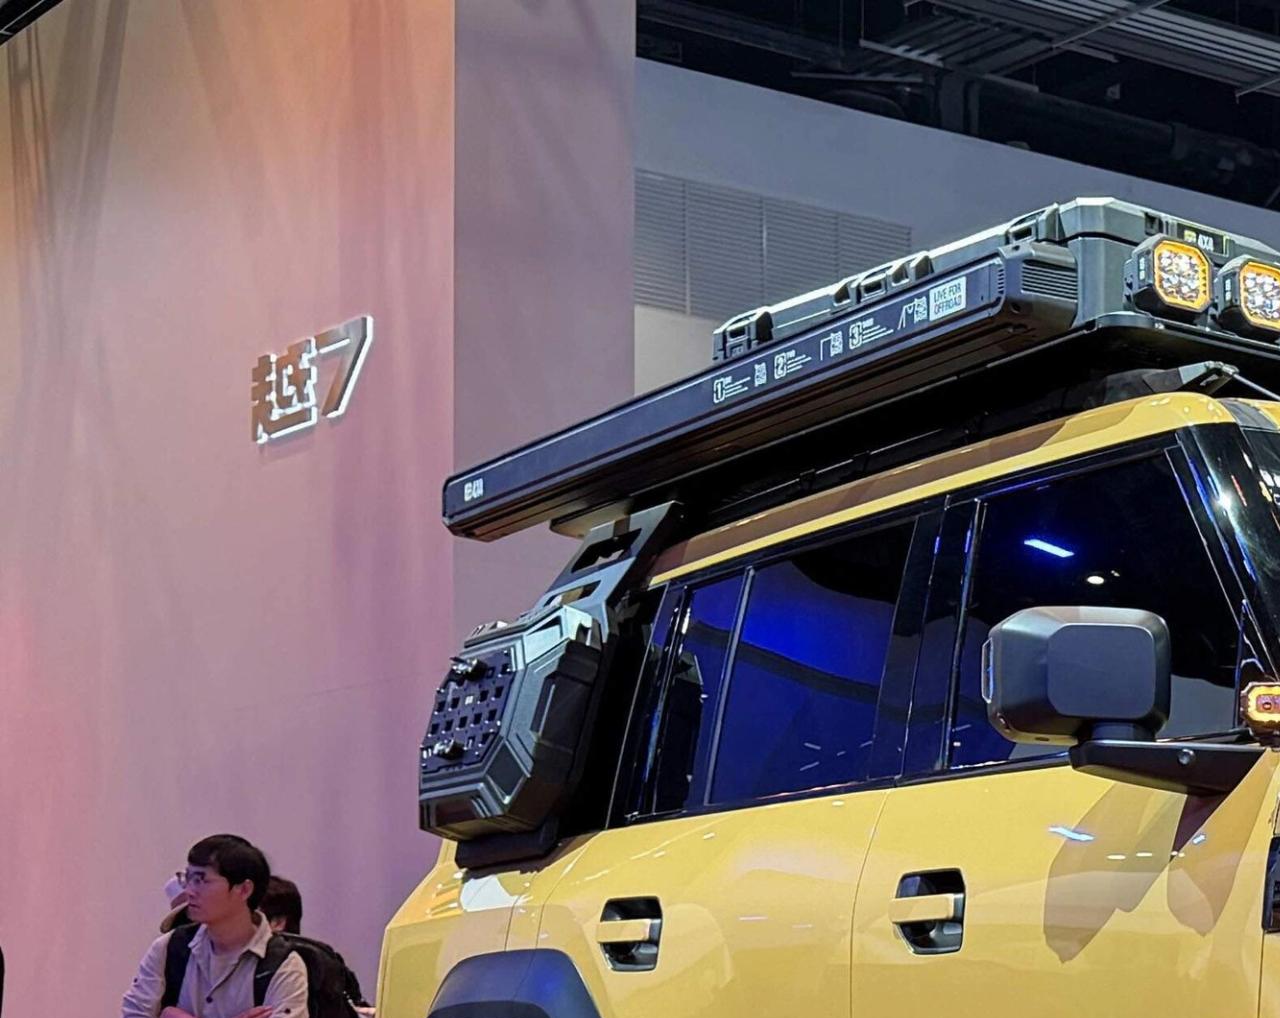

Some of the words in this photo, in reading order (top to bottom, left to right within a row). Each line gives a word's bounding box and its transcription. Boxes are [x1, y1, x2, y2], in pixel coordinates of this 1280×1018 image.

[934, 288, 947, 303] LIVE
[949, 283, 961, 297] FOR
[251, 314, 374, 444] 越7
